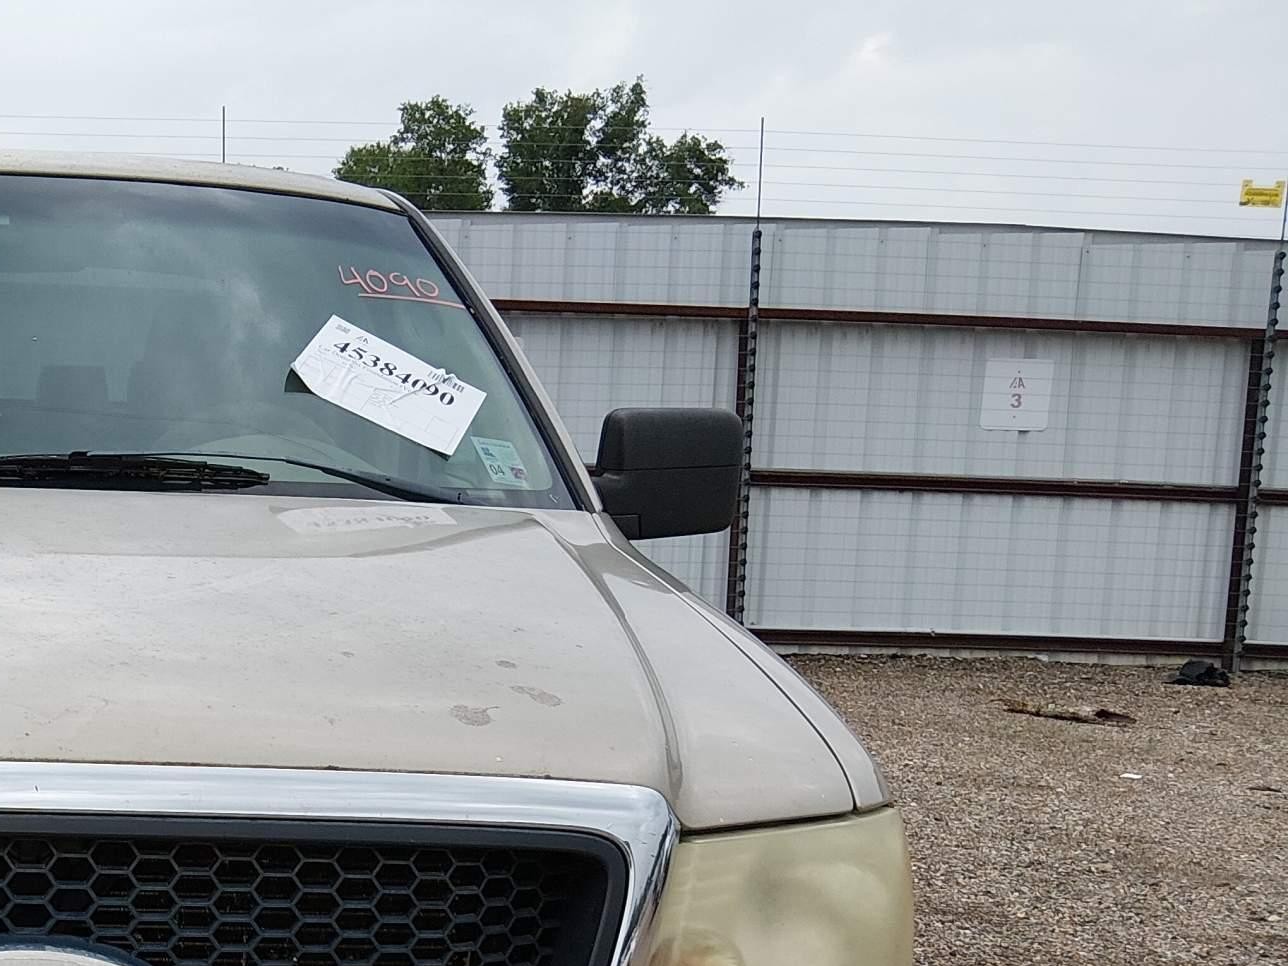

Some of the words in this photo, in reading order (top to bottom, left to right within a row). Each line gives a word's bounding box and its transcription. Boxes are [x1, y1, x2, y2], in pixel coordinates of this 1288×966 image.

[338, 265, 439, 297] 4090
[333, 342, 455, 406] 45384090
[1010, 393, 1022, 409] 3
[489, 464, 505, 476] 04
